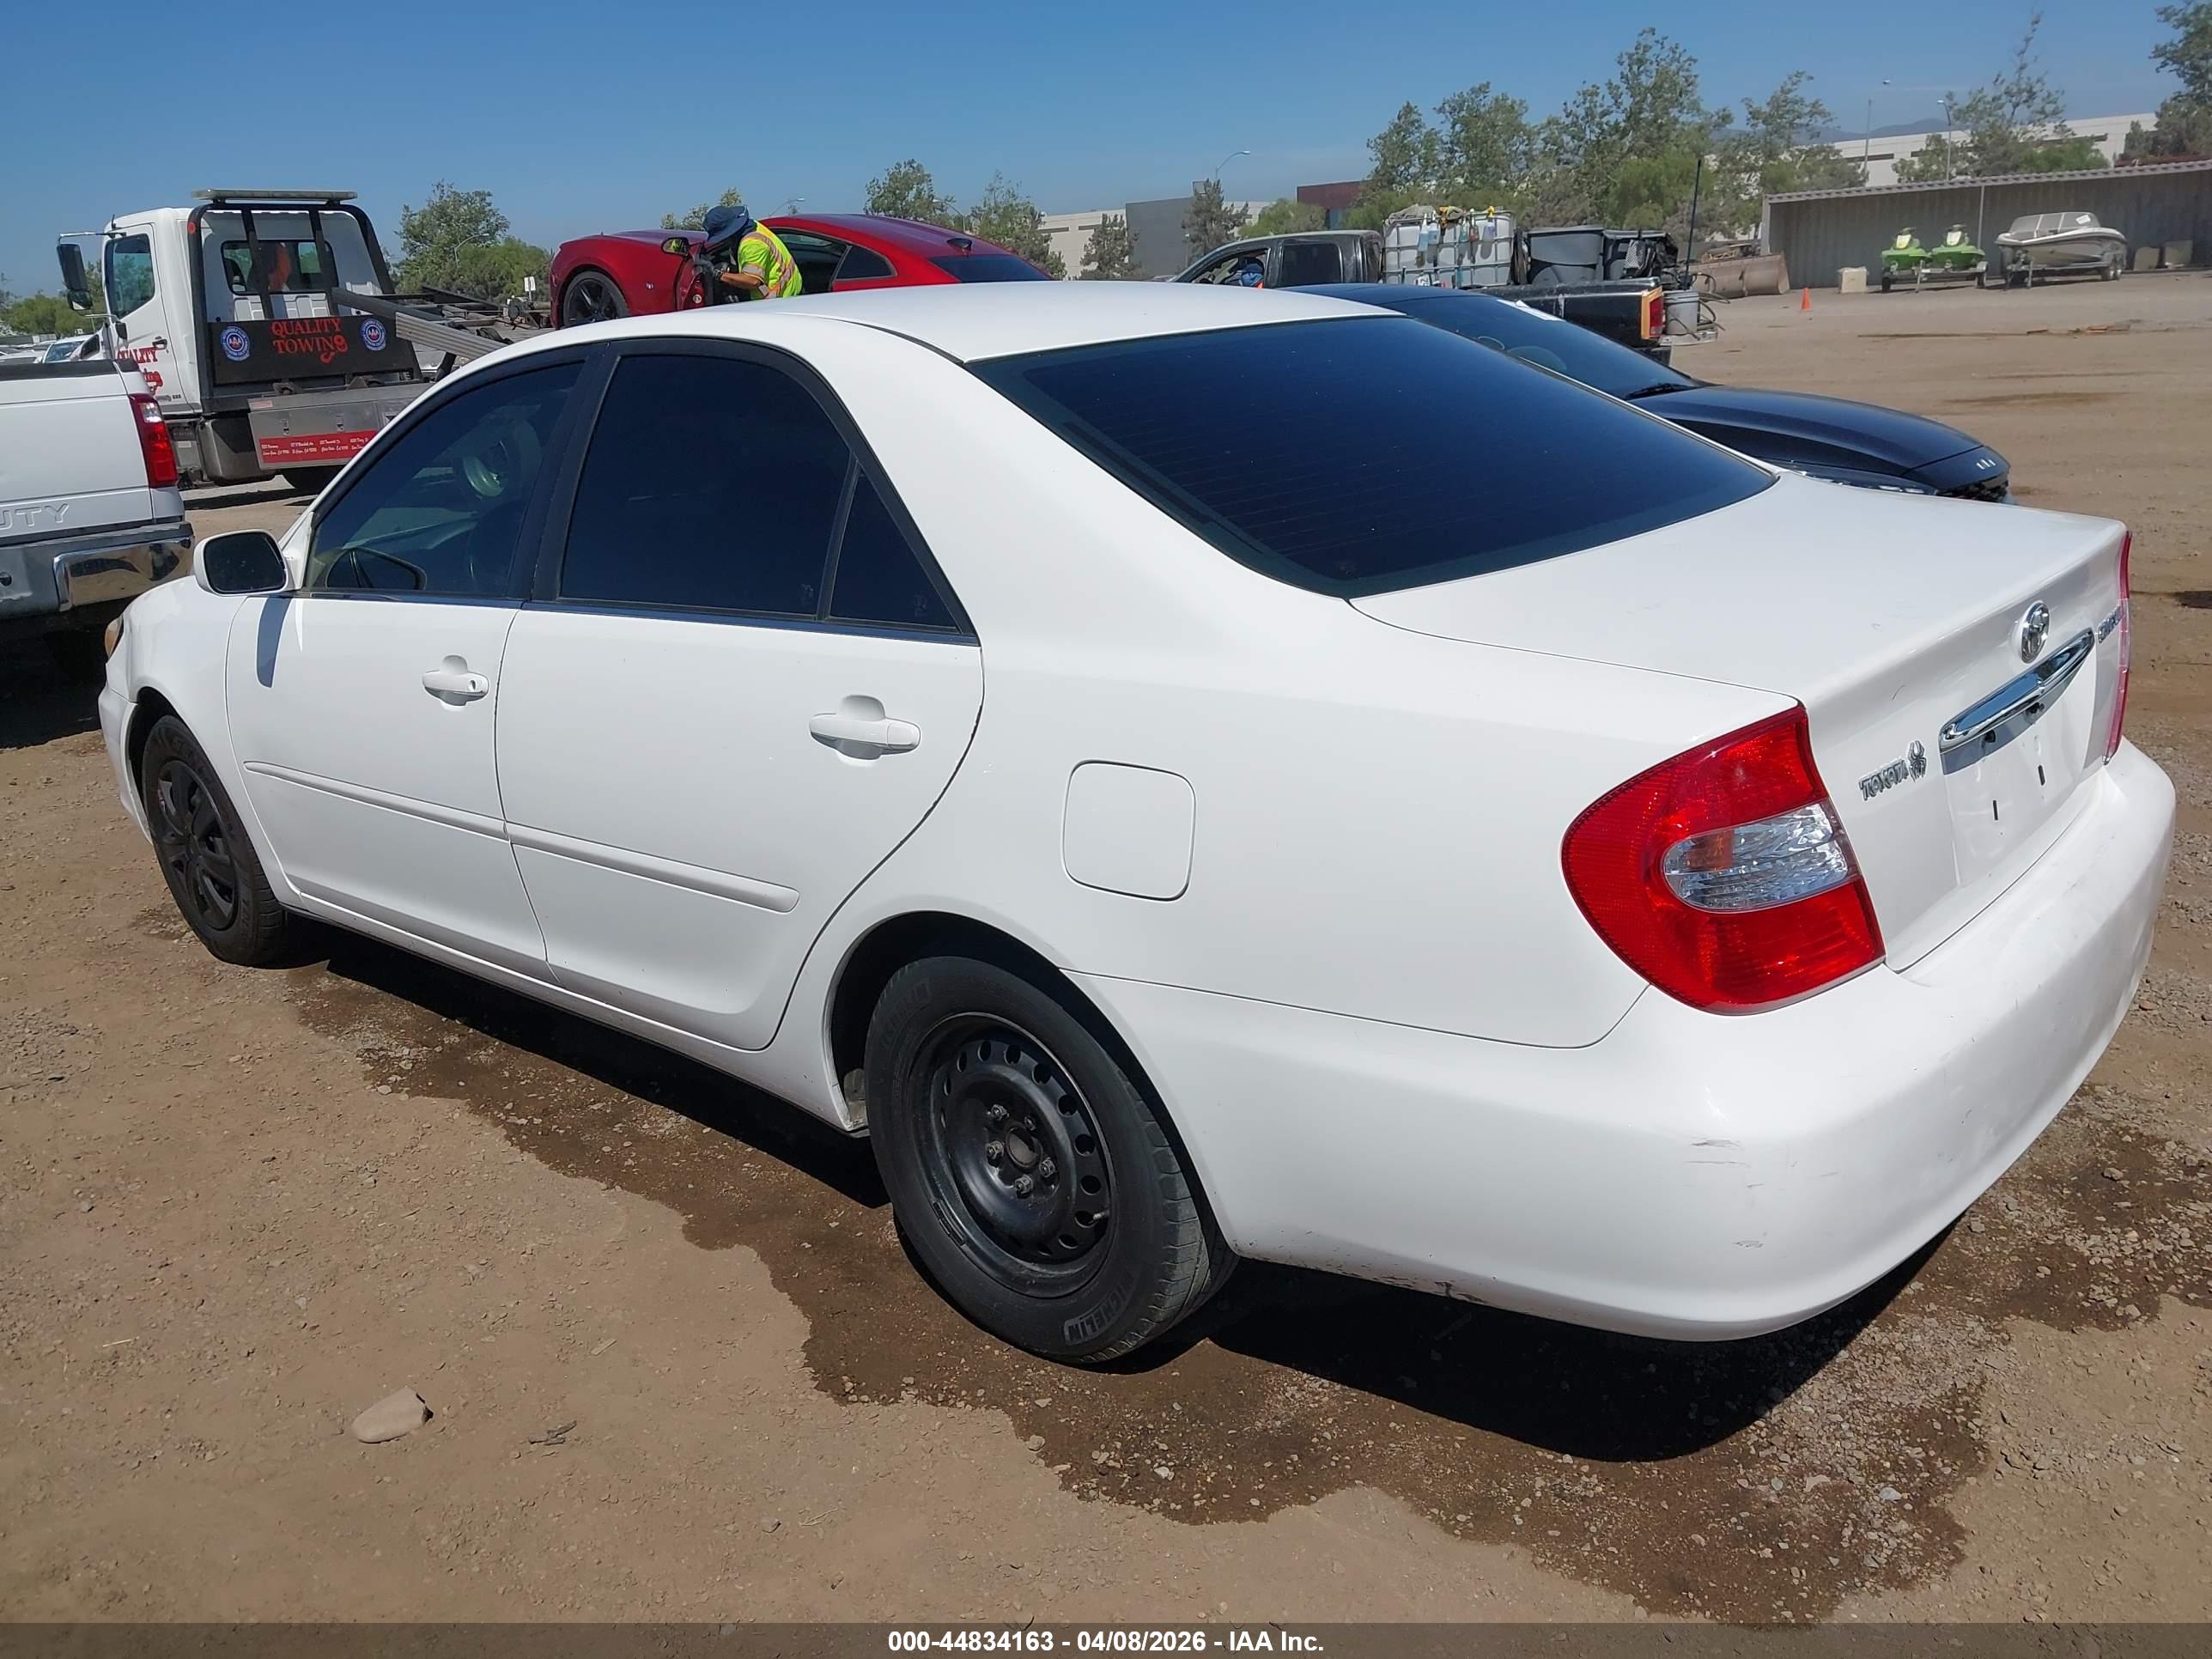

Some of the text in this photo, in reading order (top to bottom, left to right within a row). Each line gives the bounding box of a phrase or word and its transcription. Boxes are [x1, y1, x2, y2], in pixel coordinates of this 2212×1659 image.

[270, 317, 342, 338] QUALITY
[228, 336, 242, 345] AAA
[273, 334, 348, 362] TOWING
[1859, 759, 1910, 801] TOYOTA
